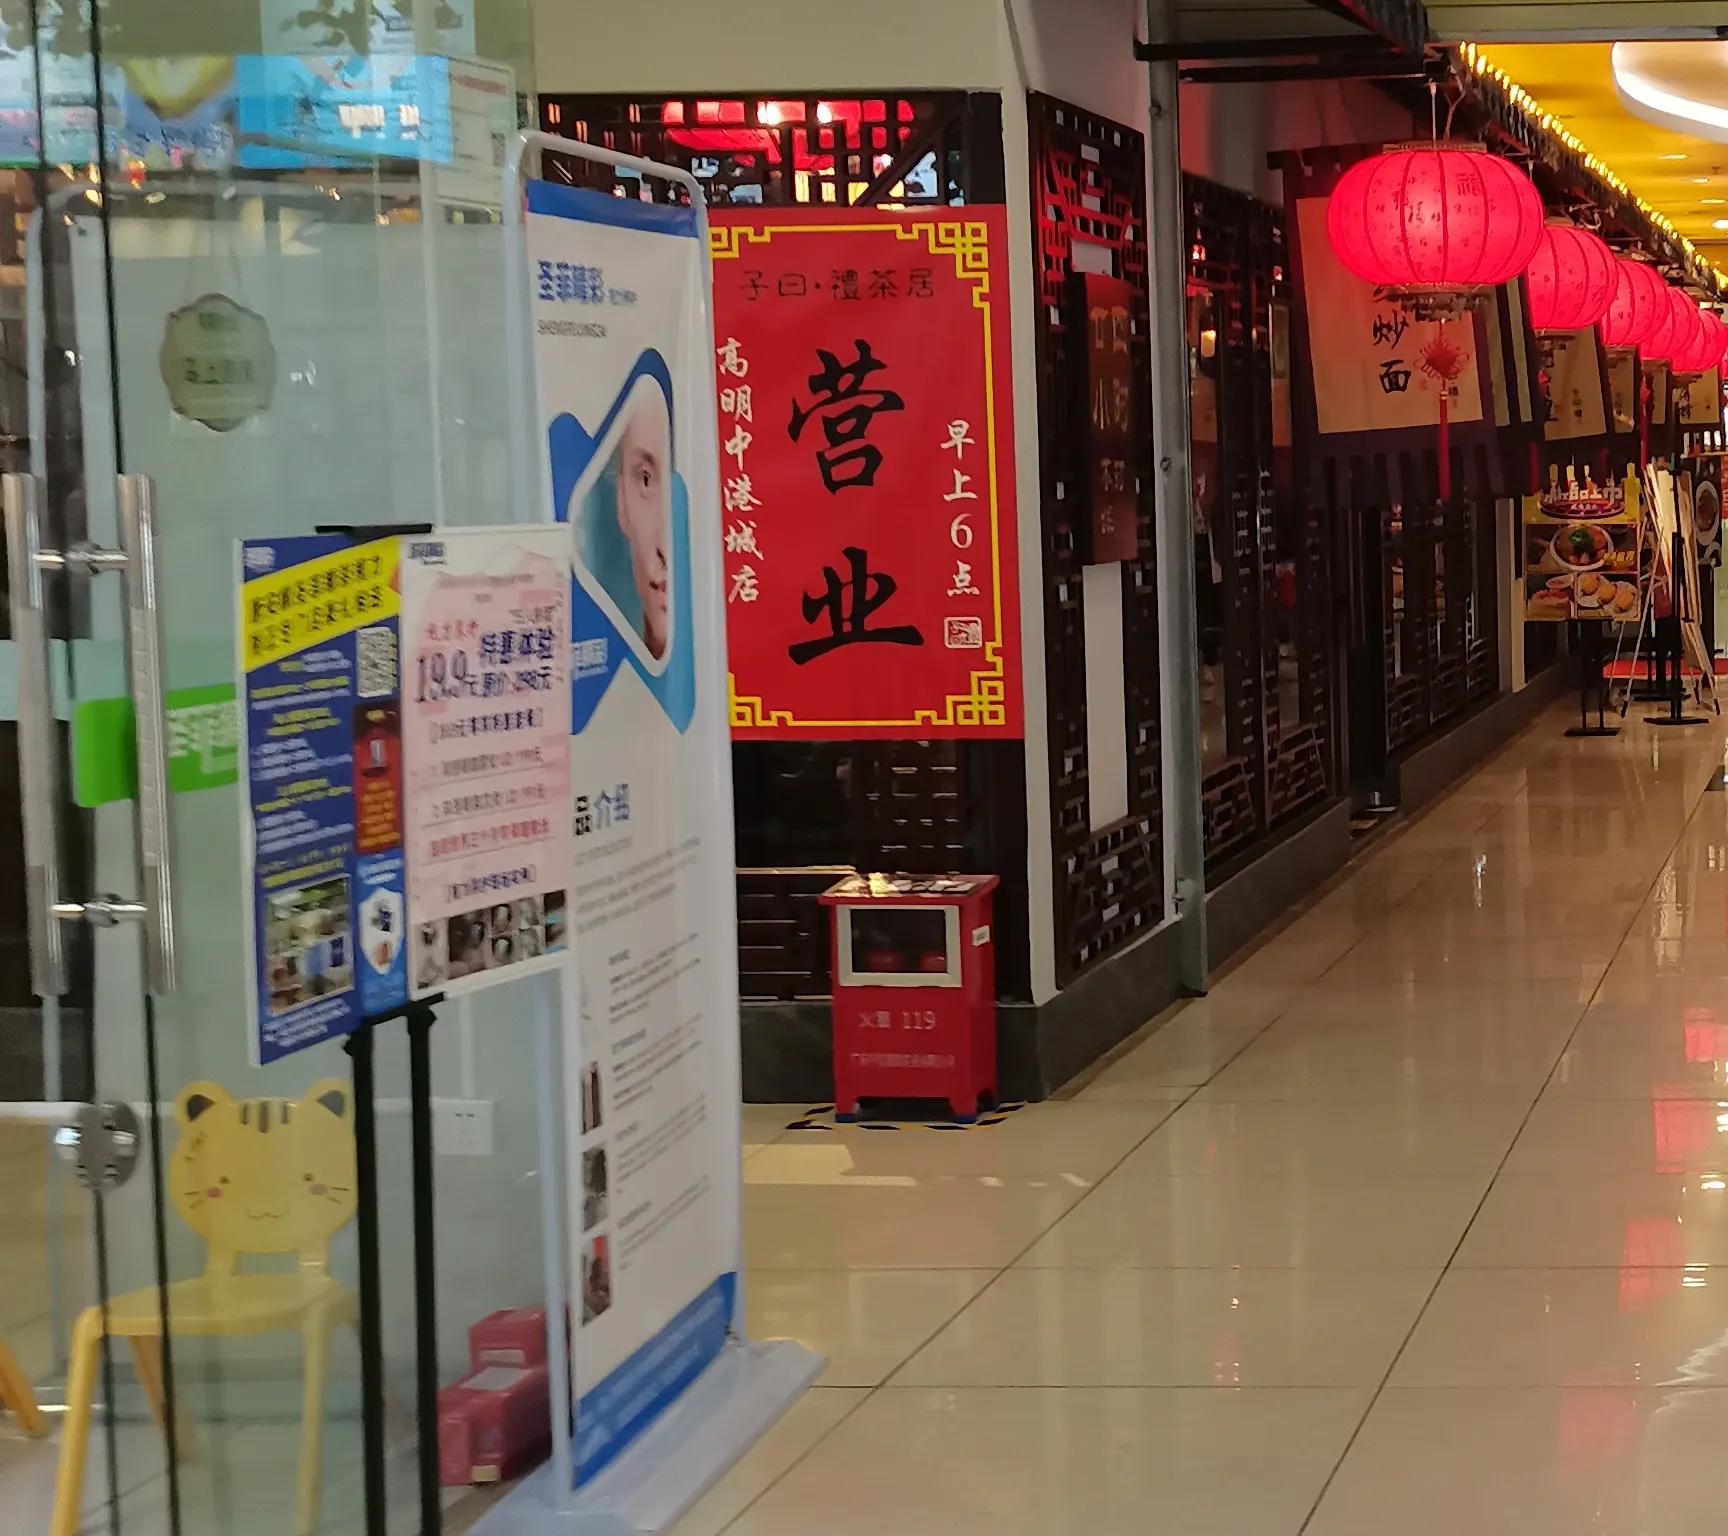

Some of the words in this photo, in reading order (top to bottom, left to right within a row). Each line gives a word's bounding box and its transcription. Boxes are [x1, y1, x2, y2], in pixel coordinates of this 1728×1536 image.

[714, 336, 764, 605] 高明中港城店
[786, 337, 926, 666] 营业
[938, 418, 982, 598] 早上6点
[902, 1011, 936, 1030] 119
